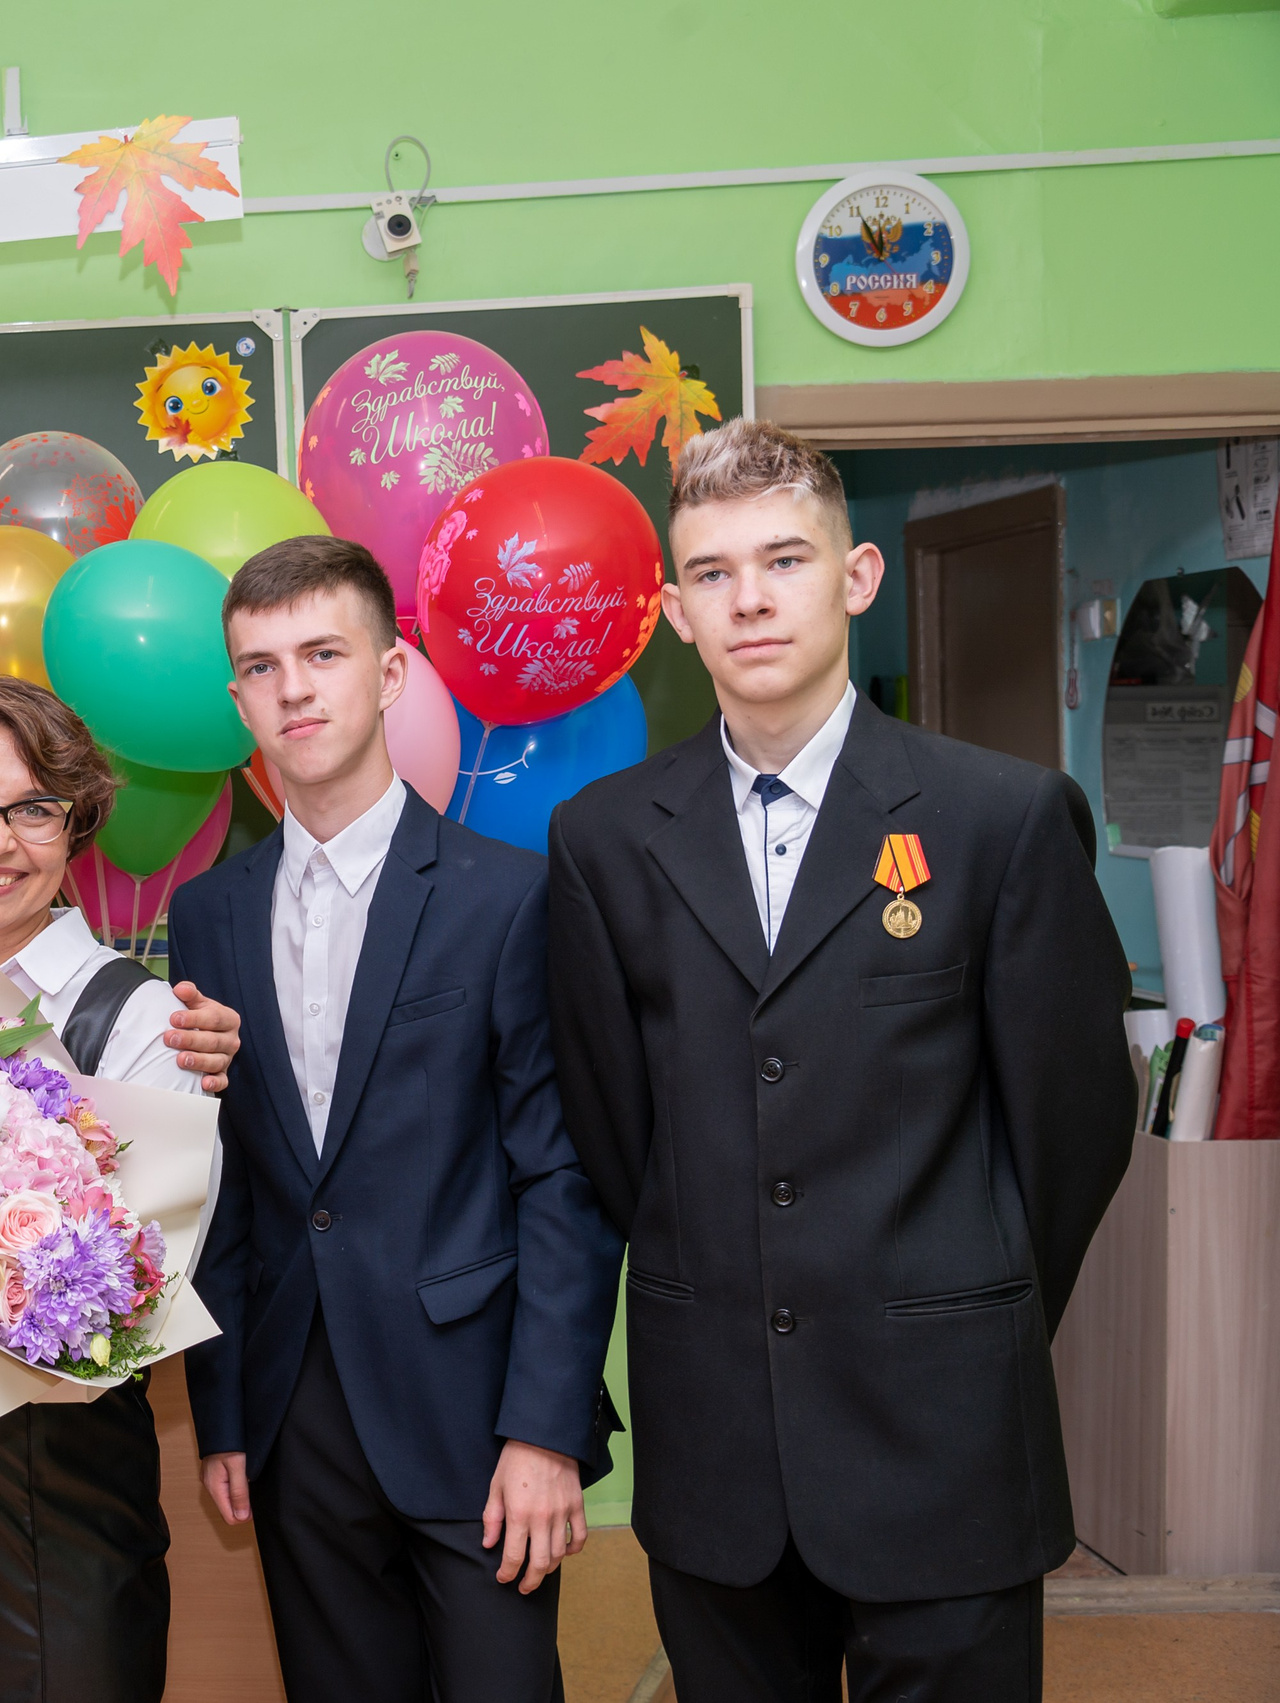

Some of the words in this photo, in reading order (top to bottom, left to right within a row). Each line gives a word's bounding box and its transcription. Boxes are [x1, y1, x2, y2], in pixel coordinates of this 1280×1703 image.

[875, 196, 889, 208] 12
[904, 202, 911, 214] 1
[848, 205, 862, 218] 11
[827, 225, 842, 237] 10
[923, 222, 934, 236] 2
[820, 253, 829, 267] 9
[931, 251, 941, 265] 3
[846, 273, 917, 291] РОССИЯ
[923, 280, 934, 293] 4
[830, 283, 840, 296] 8
[849, 301, 859, 316] 7
[875, 308, 887, 322] 6
[903, 301, 912, 315] 5
[351, 364, 505, 433] Здравствуй,
[362, 401, 497, 464] Школа!
[466, 577, 627, 622] Здравствуй,
[474, 618, 612, 659] Школа!
